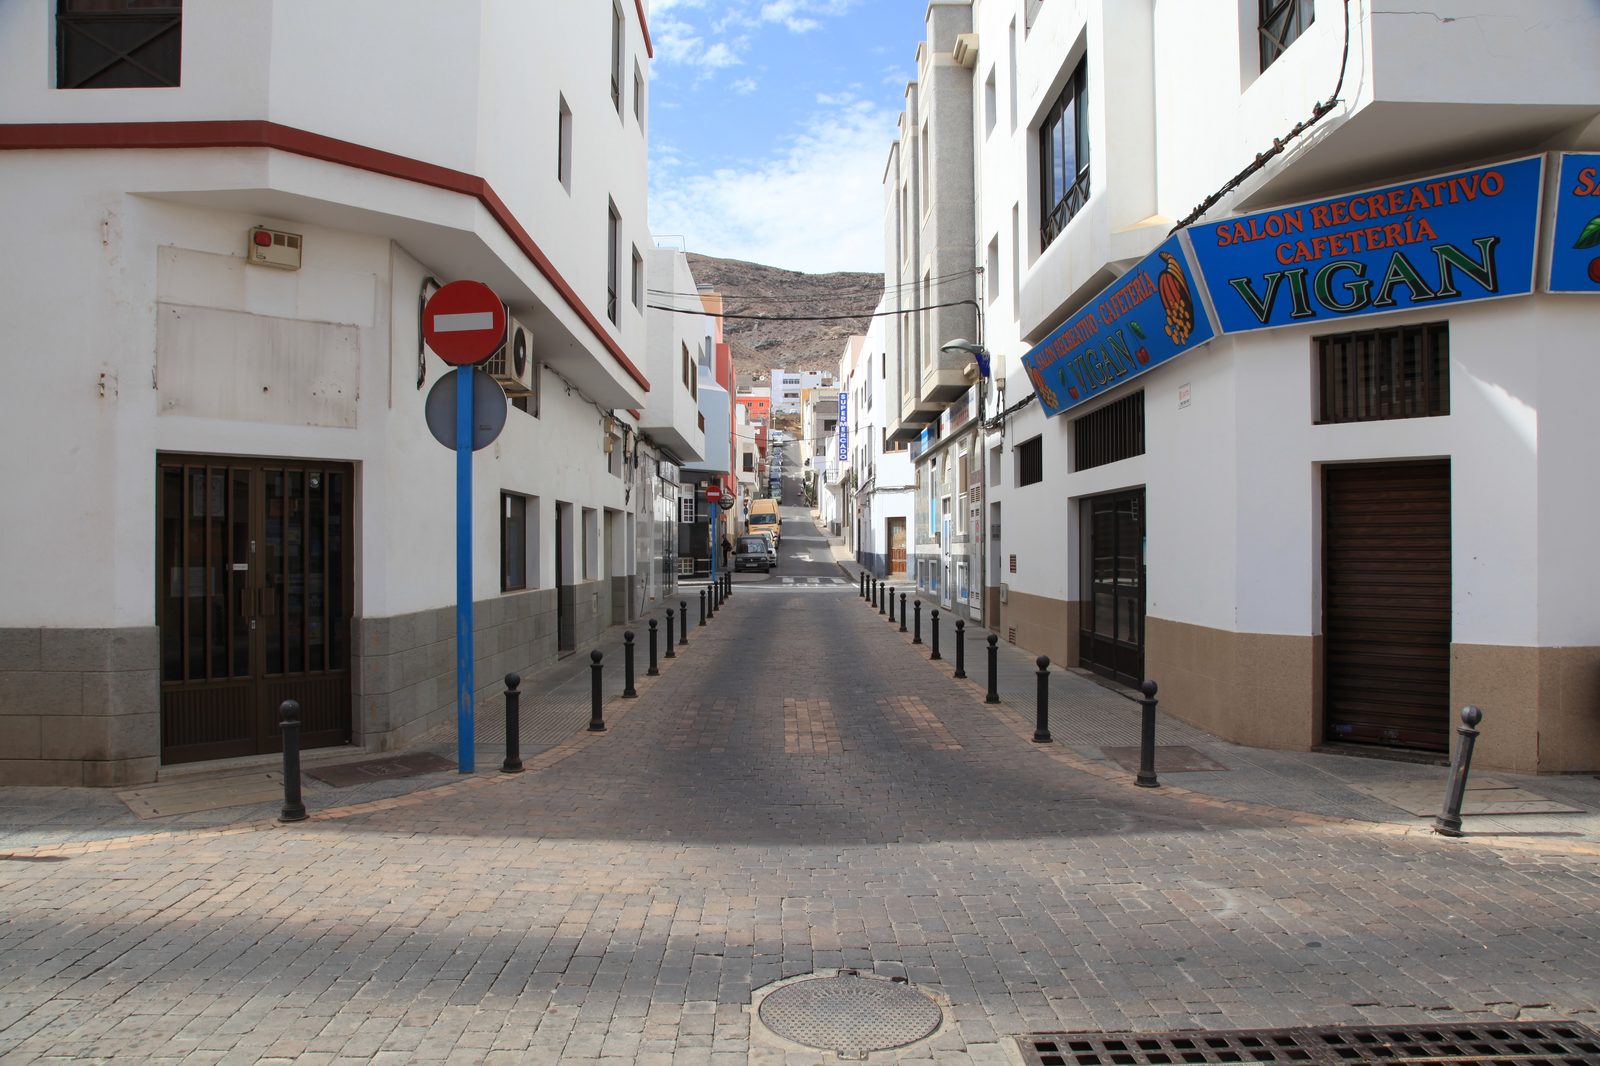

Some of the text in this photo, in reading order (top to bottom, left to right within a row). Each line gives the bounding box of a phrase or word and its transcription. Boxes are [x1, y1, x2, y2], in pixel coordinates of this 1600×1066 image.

[1216, 170, 1505, 247] SALON RECREATIVO
[1275, 214, 1438, 265] CAFETERÍA
[1228, 236, 1500, 324] VIGAN
[1034, 268, 1158, 371] SALON RECREATIVO CAFETERÍA
[1067, 328, 1137, 393] VIGAN
[839, 393, 847, 460] SUPERMERCADO
